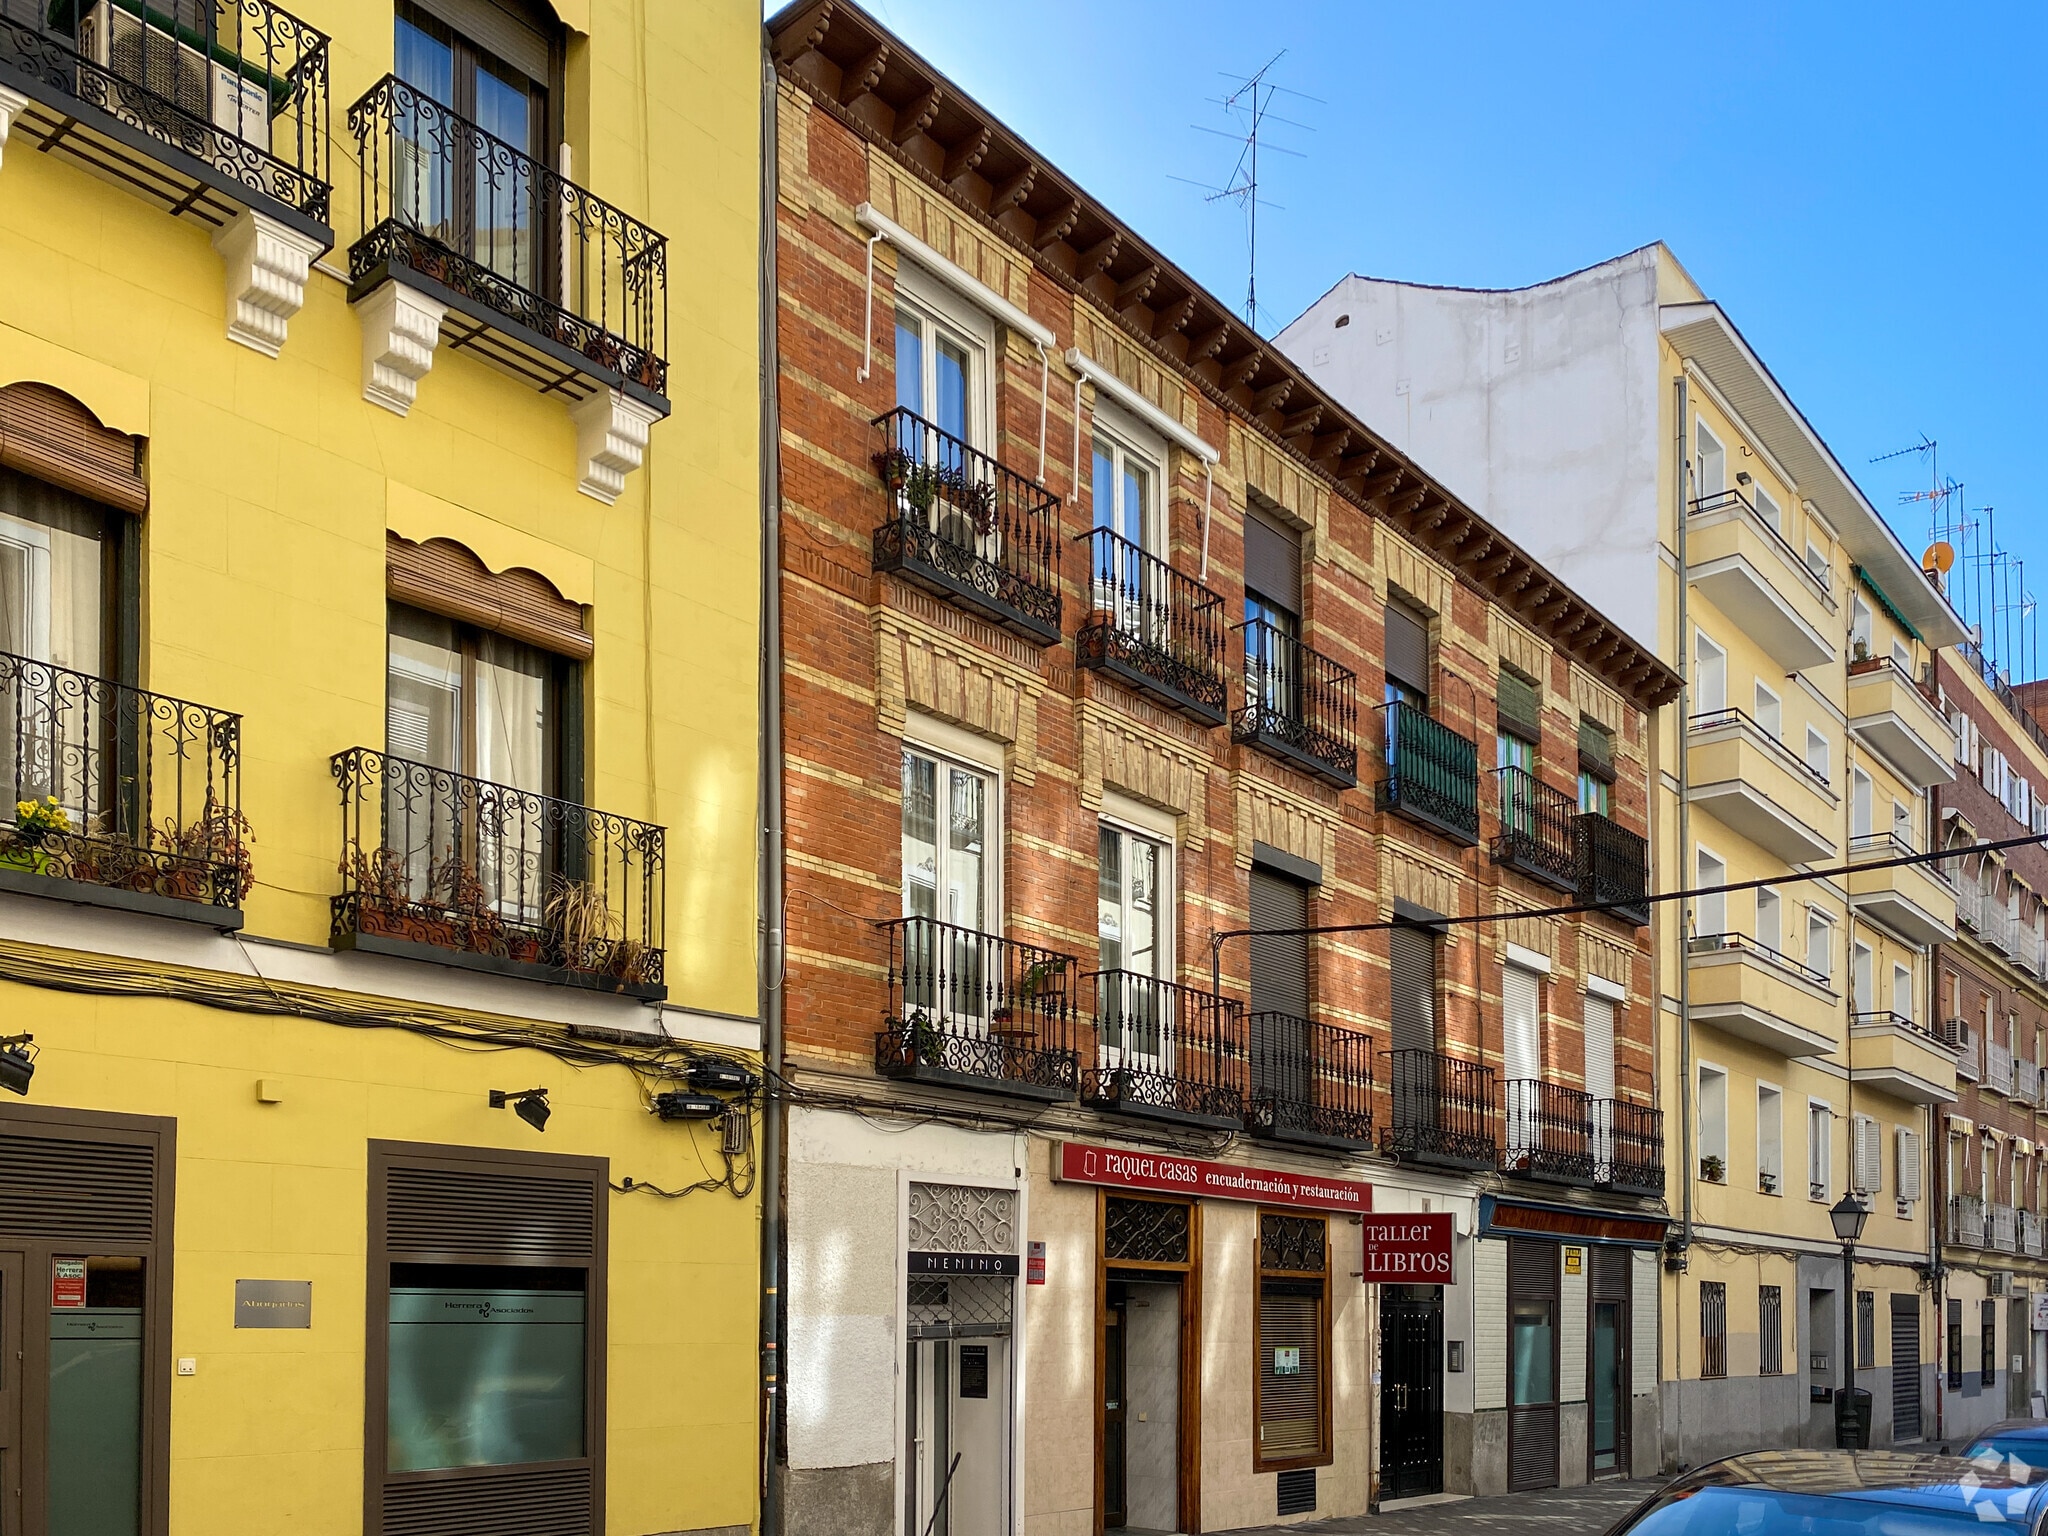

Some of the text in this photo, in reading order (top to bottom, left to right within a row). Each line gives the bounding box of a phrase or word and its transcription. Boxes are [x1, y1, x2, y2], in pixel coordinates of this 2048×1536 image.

[221, 73, 262, 102] Pansonic
[1159, 1161, 1198, 1183] casas
[1205, 1172, 1291, 1195] encuadernación
[1291, 1184, 1299, 1200] y
[1300, 1183, 1360, 1202] restauración
[444, 1301, 483, 1309] Herrera
